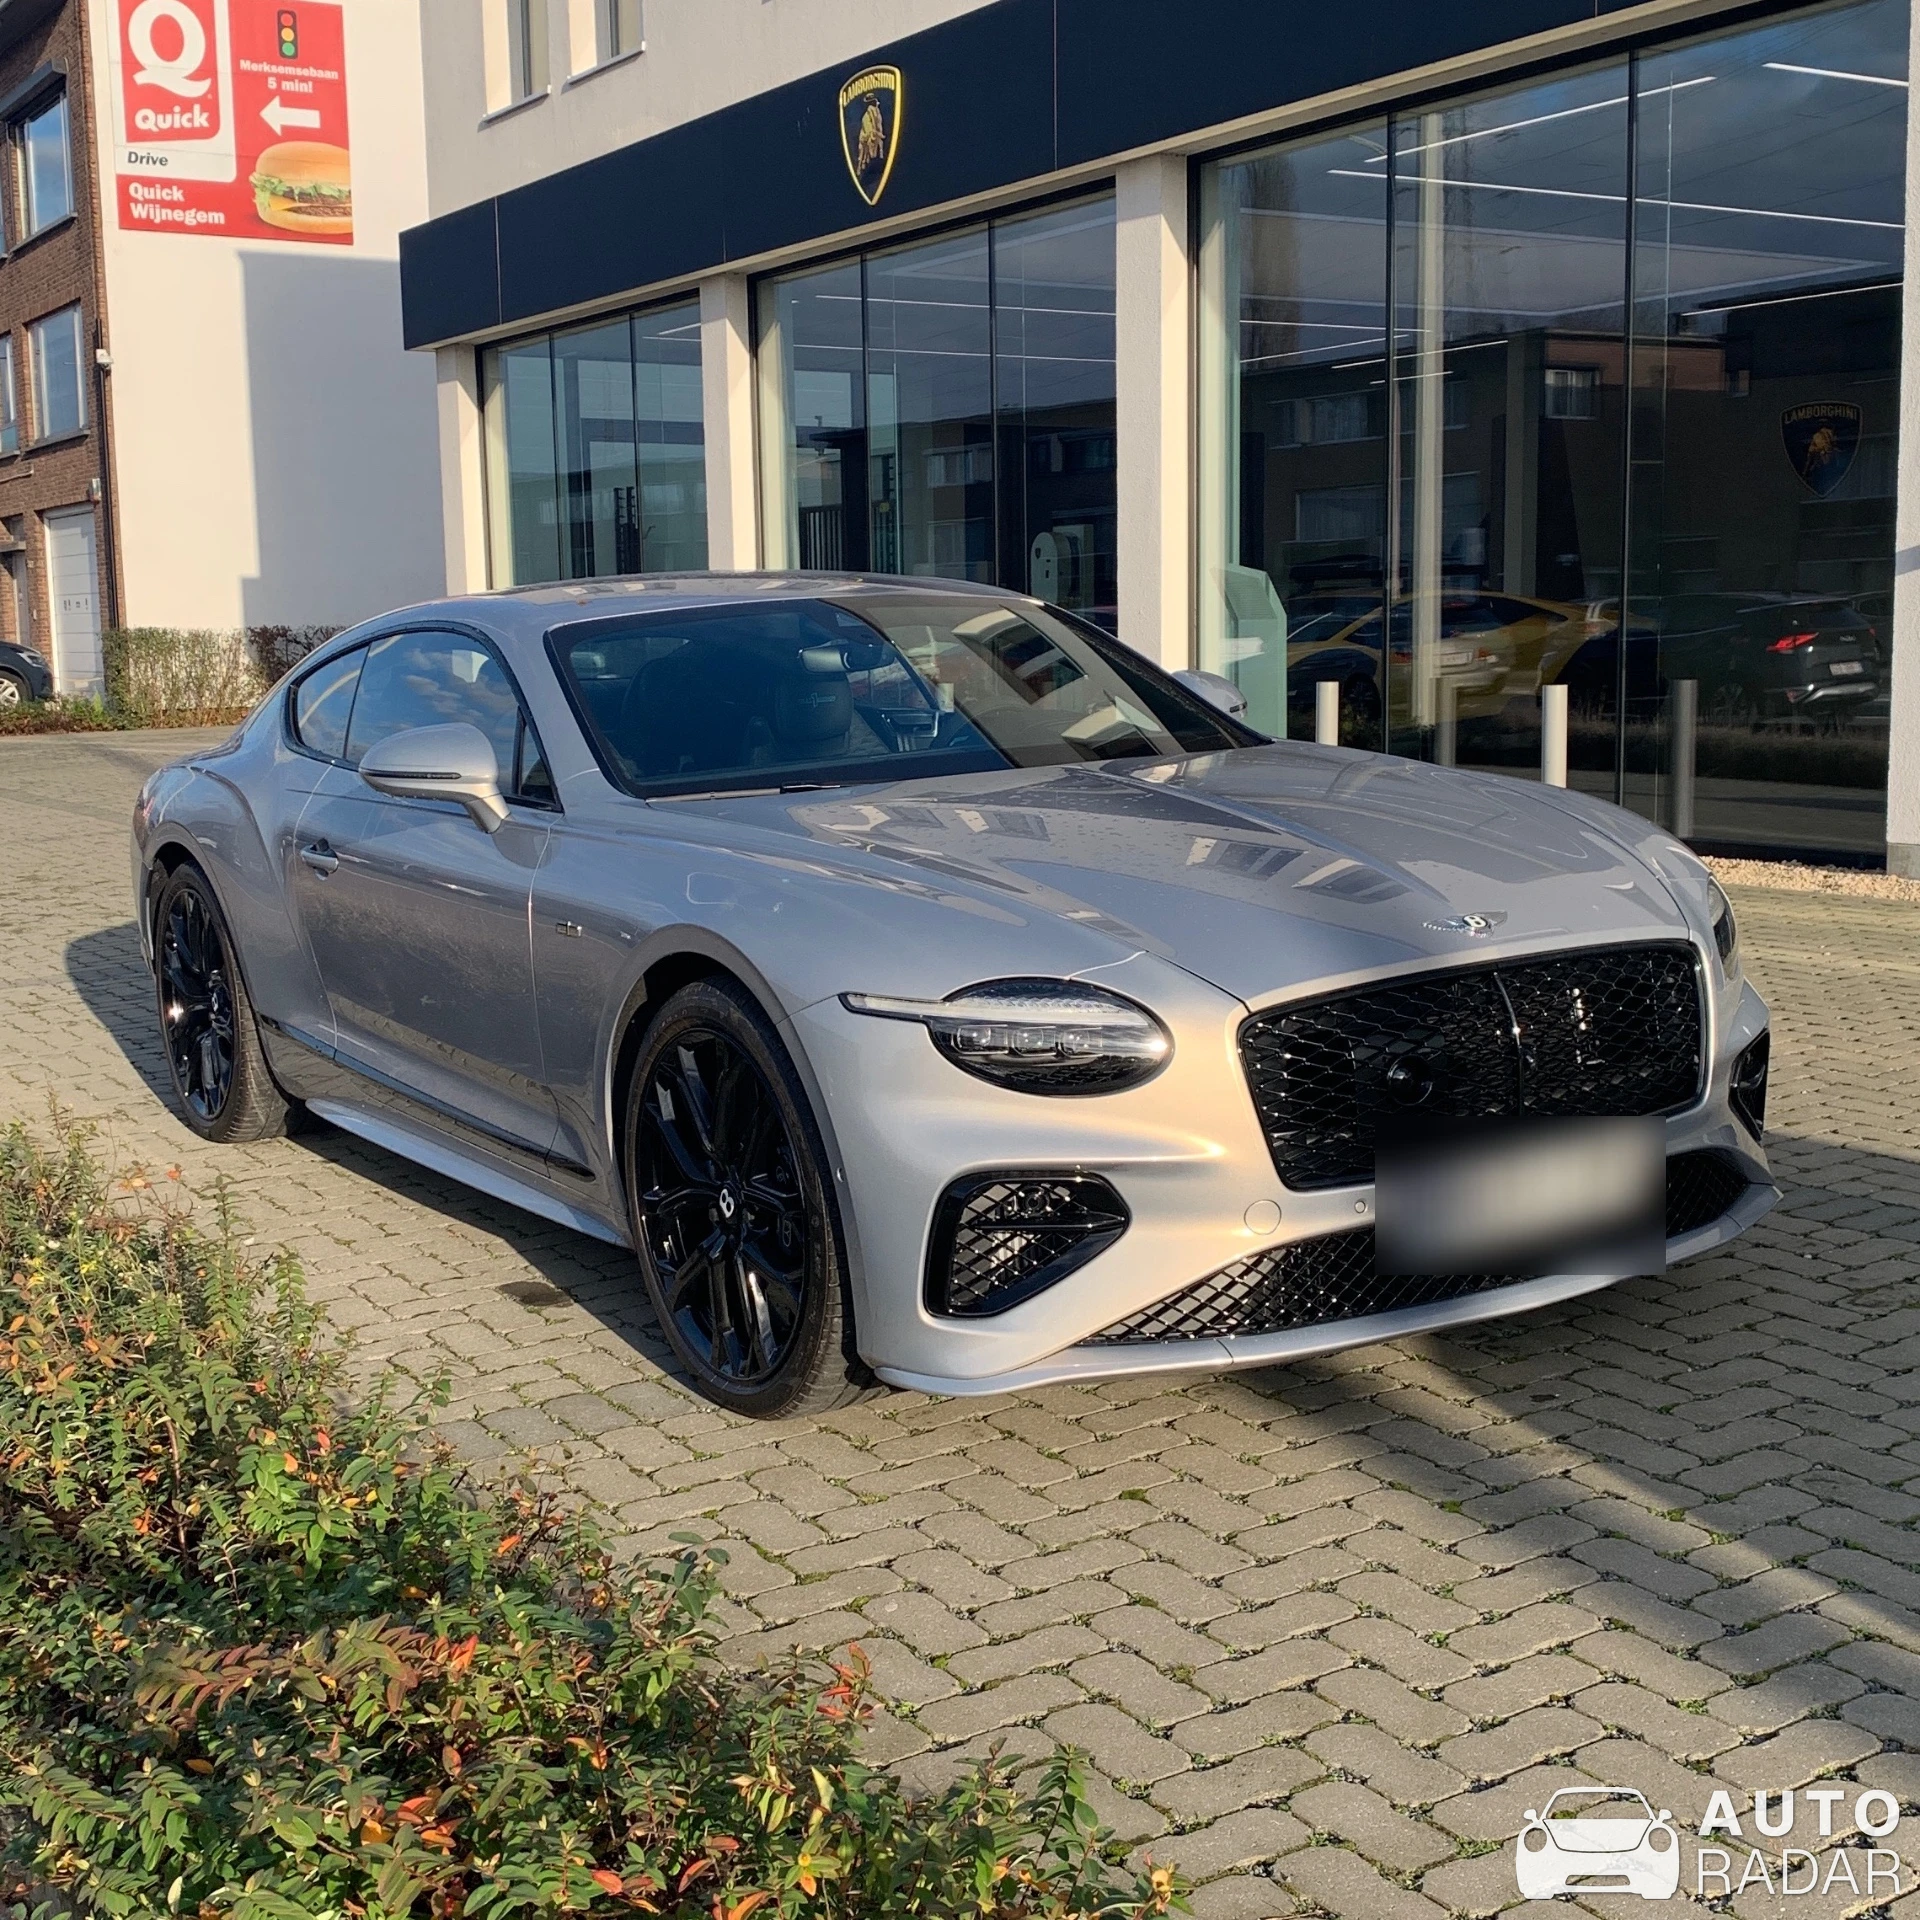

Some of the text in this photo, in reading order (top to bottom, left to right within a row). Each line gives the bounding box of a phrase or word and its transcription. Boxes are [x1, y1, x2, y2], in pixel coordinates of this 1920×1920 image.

[128, 0, 212, 98] Q
[239, 59, 339, 80] Merksemsebaan
[267, 76, 313, 93] 5 min!
[843, 72, 895, 107] LAMBORGHINI
[134, 103, 210, 132] Quick
[127, 151, 169, 166] Drive
[128, 182, 185, 202] Quick
[129, 202, 226, 226] Wijnegem
[1784, 404, 1858, 425] LAMBORGHINI
[719, 1188, 735, 1219] B
